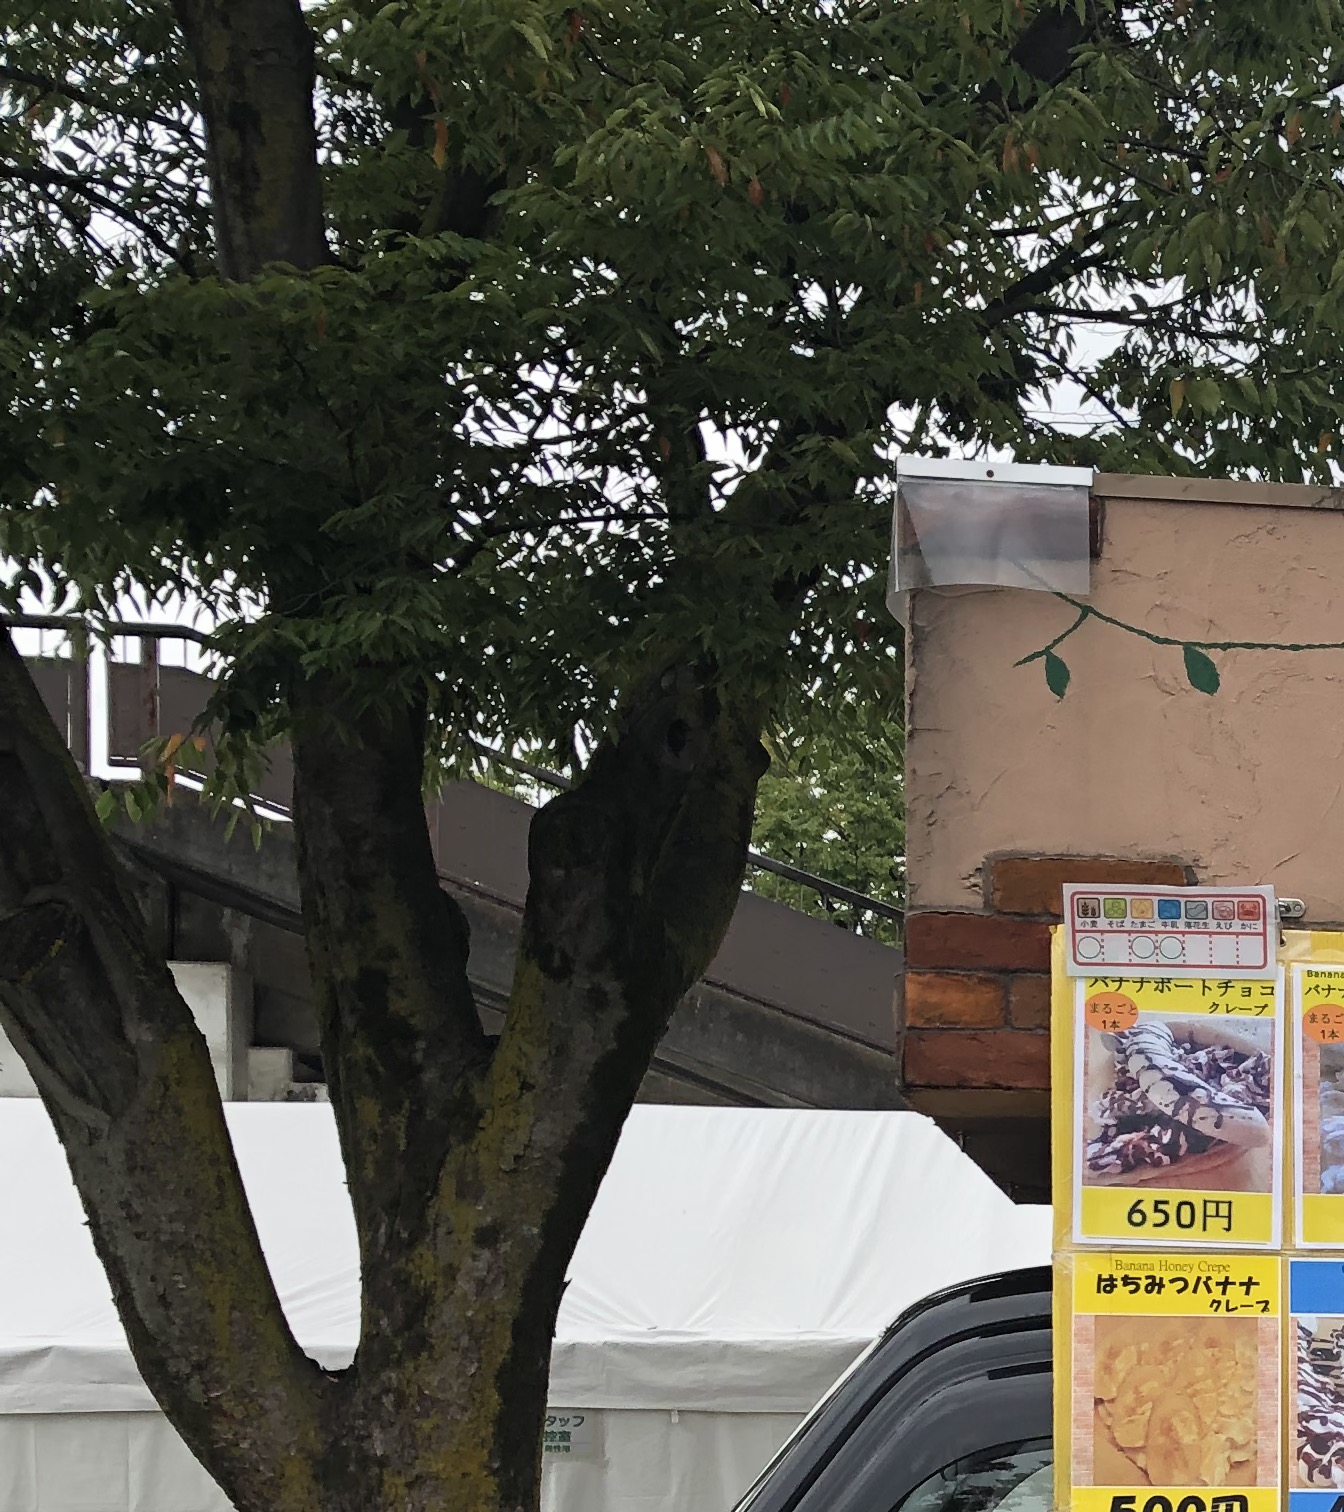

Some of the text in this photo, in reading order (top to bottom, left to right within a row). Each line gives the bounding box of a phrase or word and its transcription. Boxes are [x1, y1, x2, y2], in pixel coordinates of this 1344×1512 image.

[1107, 920, 1125, 928] そば
[1131, 920, 1156, 929] たまご
[1215, 921, 1233, 931] えび
[1089, 977, 1275, 998] バナナボートチョコ
[1089, 1002, 1138, 1016] まるごと
[1208, 1001, 1269, 1016] クレープ
[1101, 1019, 1121, 1030] 1本
[1320, 1030, 1340, 1040] 1本
[1127, 1199, 1233, 1232] 650円
[1114, 1260, 1230, 1275] Banana Honey Crepe
[1096, 1274, 1261, 1296] はちみつバナナ
[1208, 1299, 1270, 1314] クレープ
